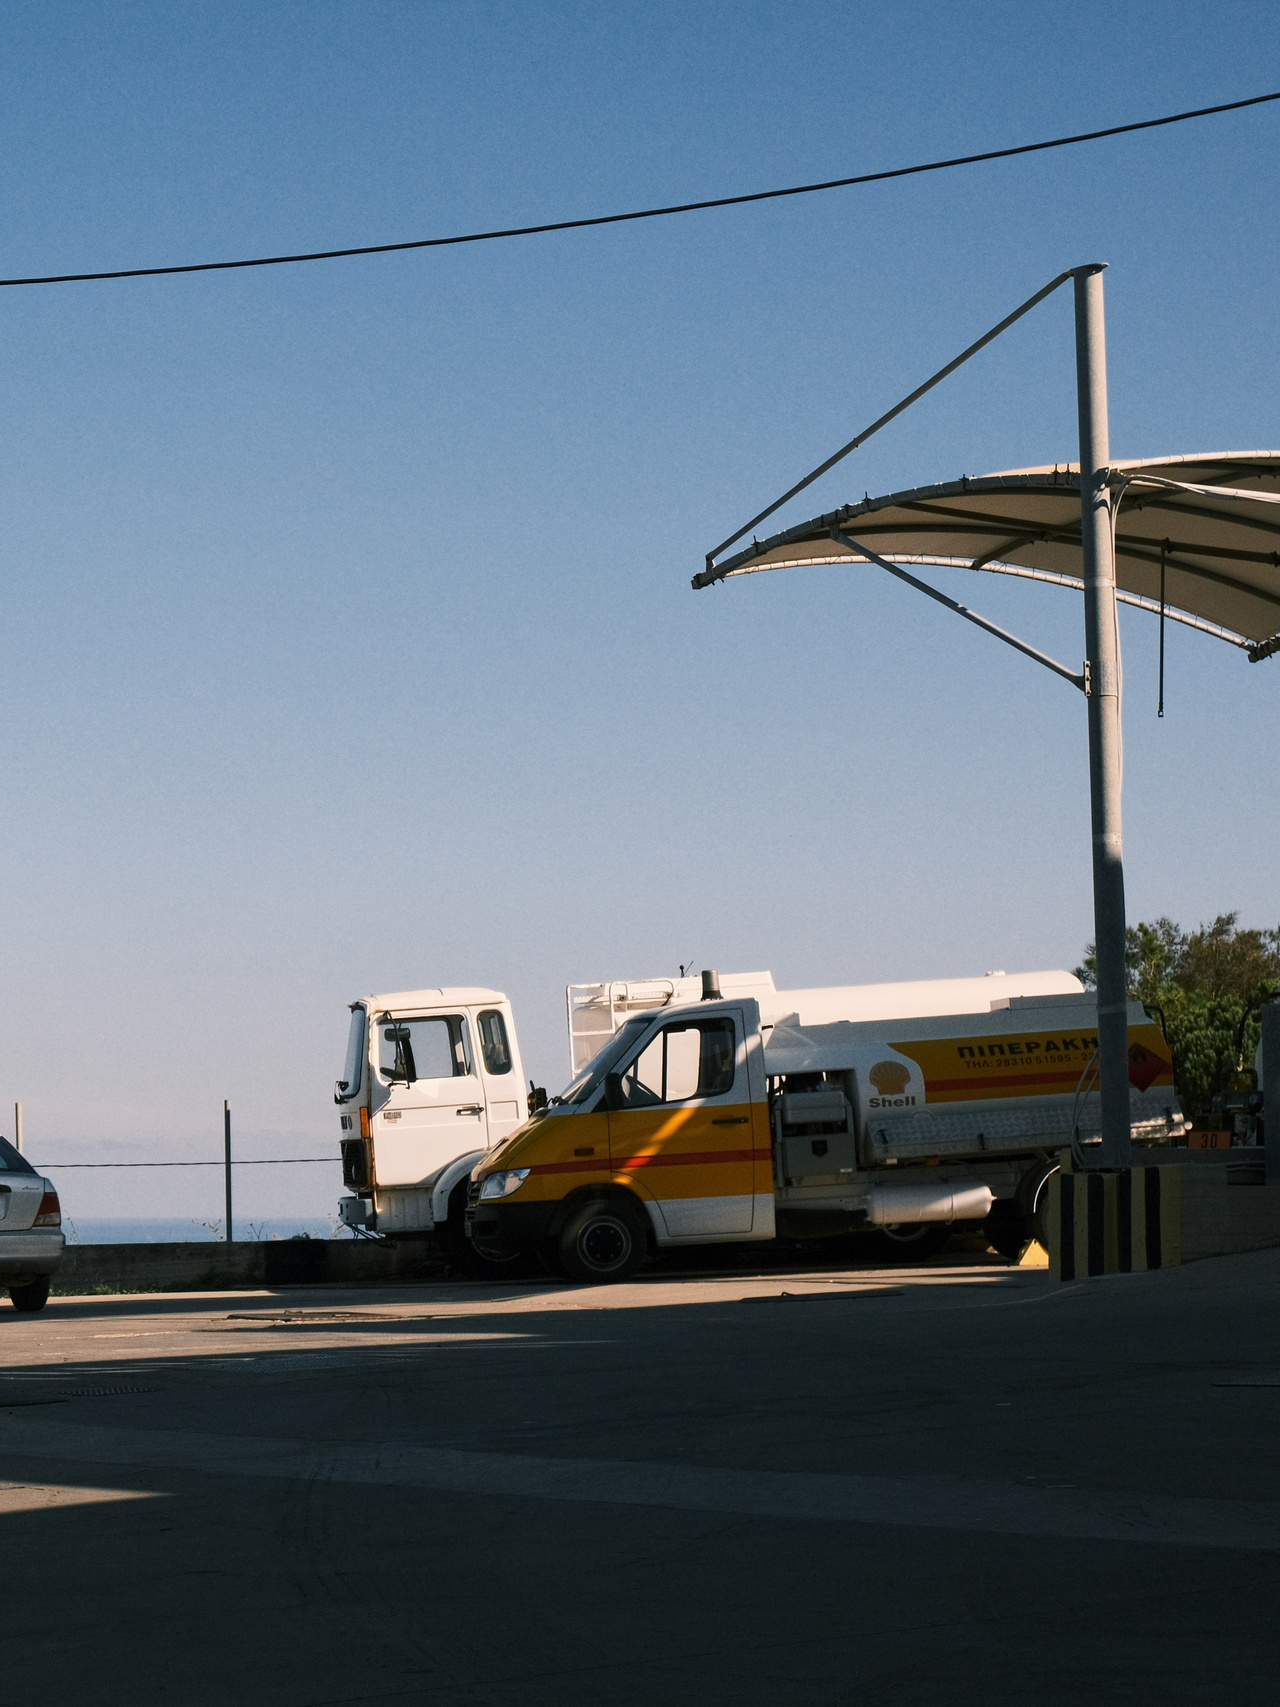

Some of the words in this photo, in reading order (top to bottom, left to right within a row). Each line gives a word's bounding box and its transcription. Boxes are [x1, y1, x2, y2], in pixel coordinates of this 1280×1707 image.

[957, 1036, 1099, 1059] ΠΙΠΕΡΑΚΗ
[996, 1056, 1032, 1067] 28310
[1035, 1053, 1072, 1064] 51595
[869, 1096, 916, 1109] Shell
[1201, 1133, 1218, 1148] 30
